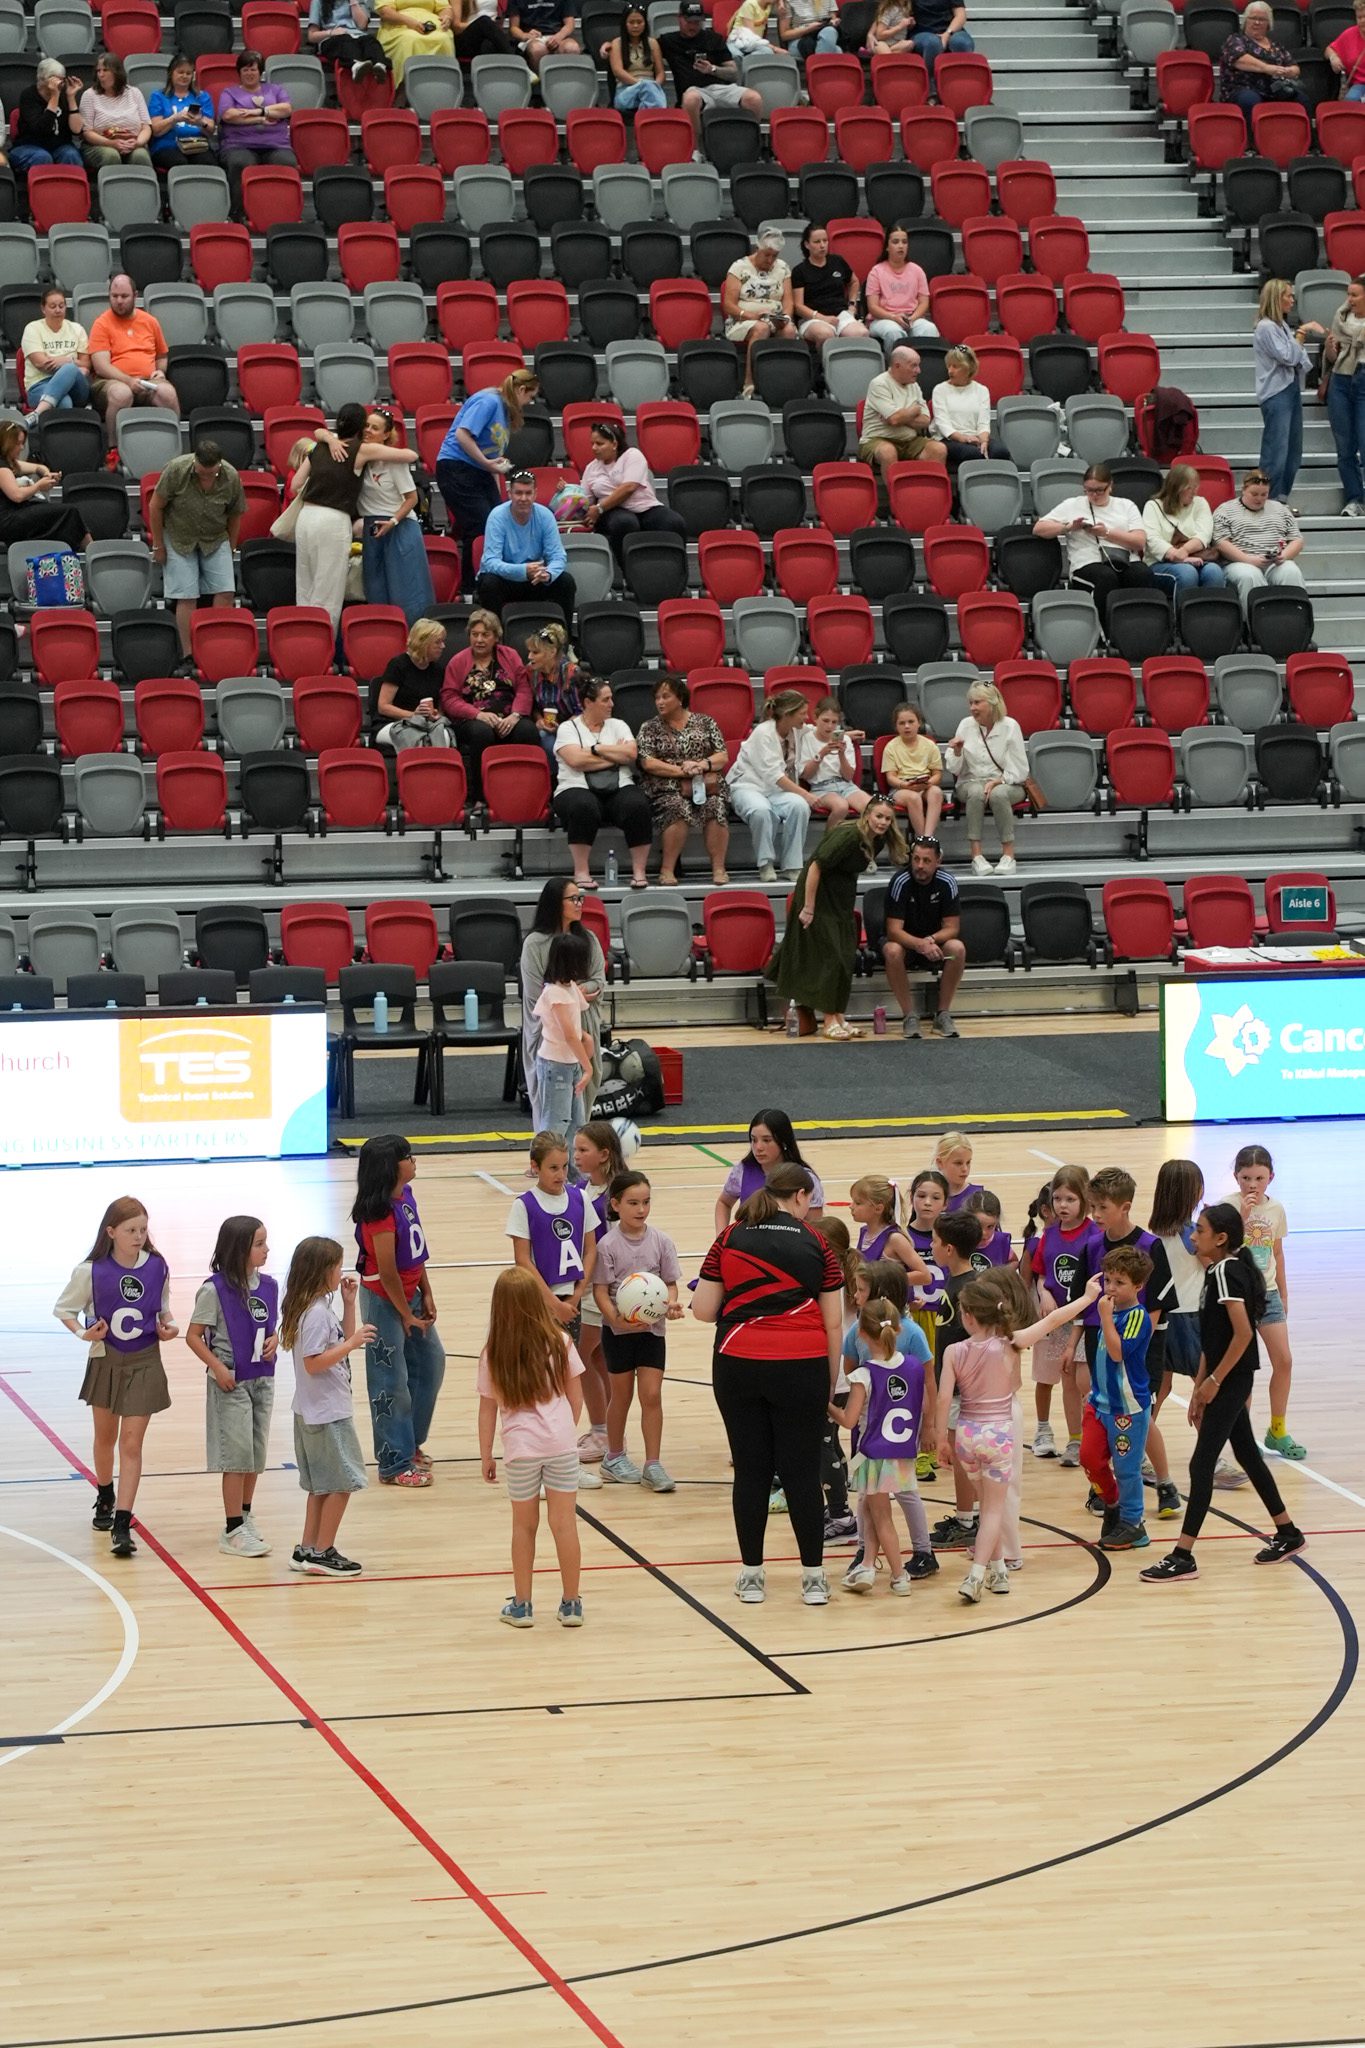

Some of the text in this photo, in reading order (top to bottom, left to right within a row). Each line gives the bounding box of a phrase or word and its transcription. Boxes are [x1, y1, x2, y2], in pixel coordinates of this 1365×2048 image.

[1288, 898, 1321, 908] Aisle 6
[1279, 1022, 1365, 1054] Canc
[0, 1051, 71, 1072] hurch
[138, 1050, 252, 1086] TES
[33, 1134, 134, 1153] BUSINESS
[140, 1129, 250, 1149] PARTNERS
[409, 1223, 425, 1260] D
[758, 1224, 801, 1233] REPRESENTATIVE
[559, 1239, 584, 1277] A
[912, 1264, 946, 1303] C
[110, 1307, 144, 1341] C
[881, 1407, 913, 1444] C
